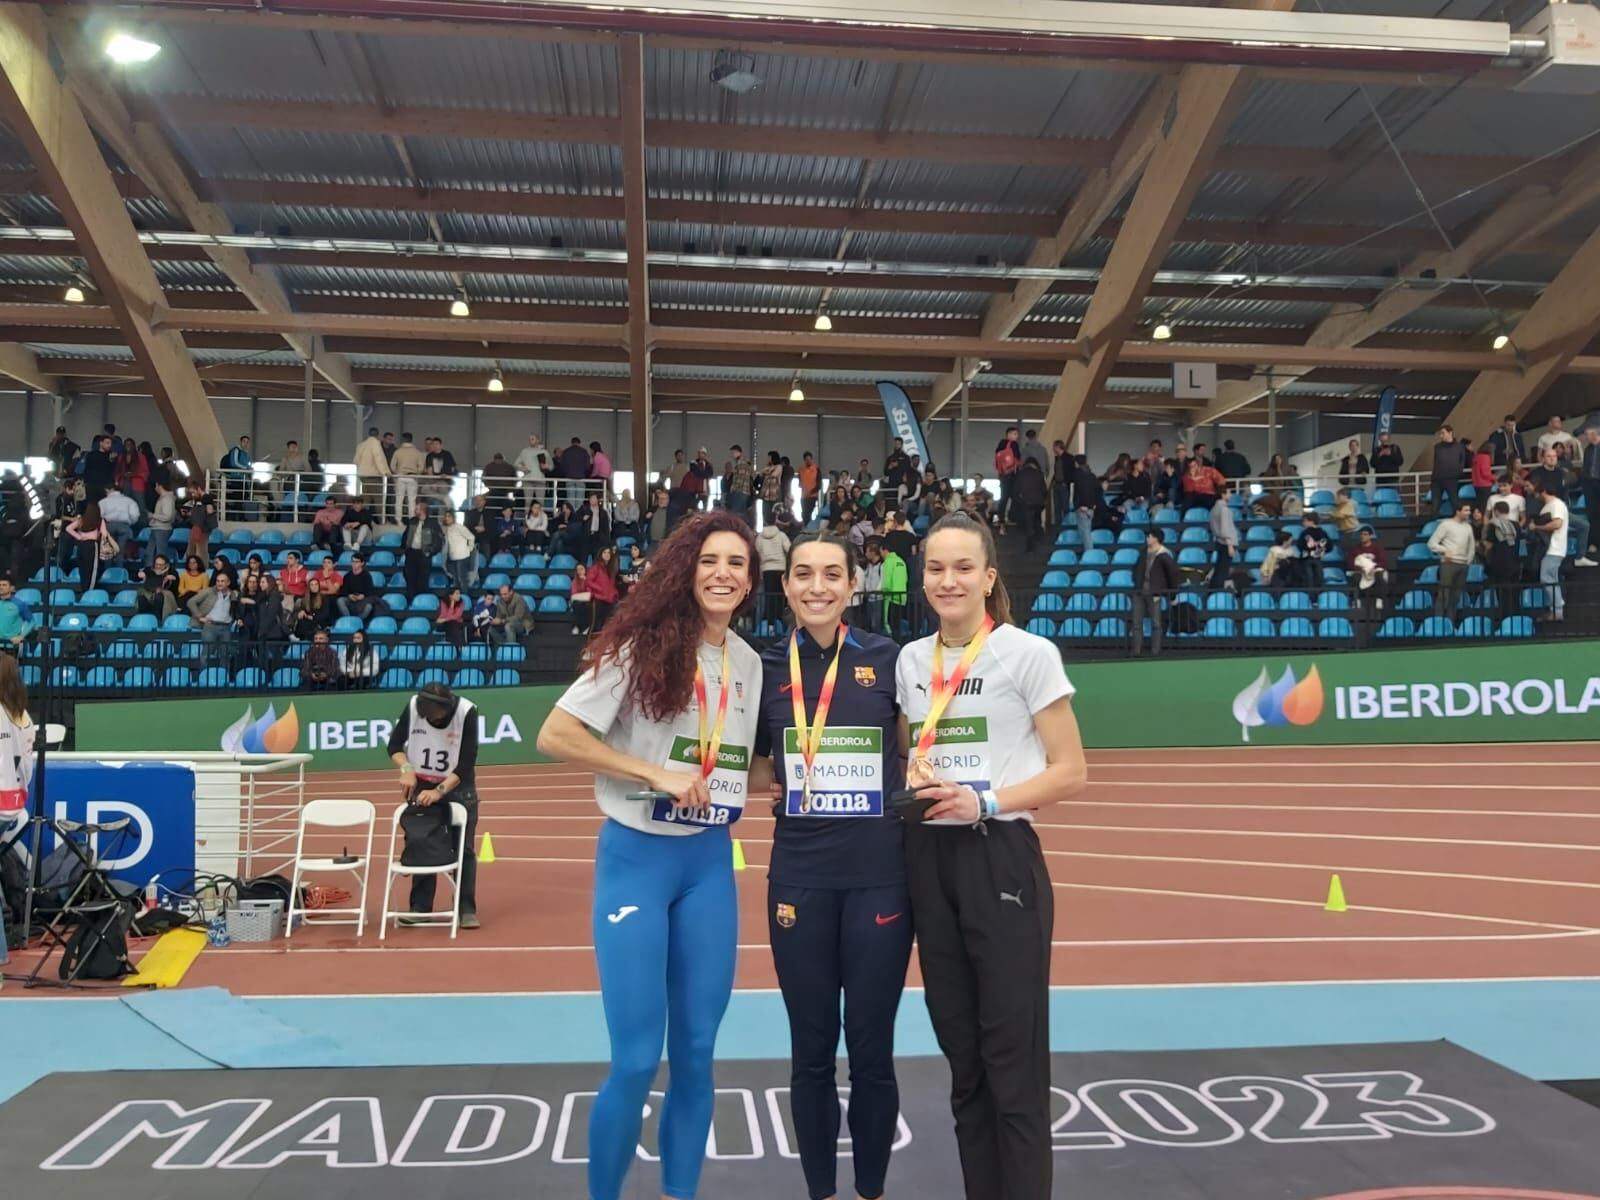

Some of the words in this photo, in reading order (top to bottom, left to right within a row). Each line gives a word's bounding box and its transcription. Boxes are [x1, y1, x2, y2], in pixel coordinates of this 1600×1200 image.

[1189, 369, 1201, 389] L
[944, 678, 983, 696] MA
[1334, 677, 1600, 720] IBERDROLA
[308, 714, 522, 750] IBERLA
[820, 737, 872, 746] BERDROLA
[420, 748, 450, 772] 13
[931, 755, 981, 769] ADRID
[813, 765, 875, 777] MADRID
[709, 779, 743, 794] DRID
